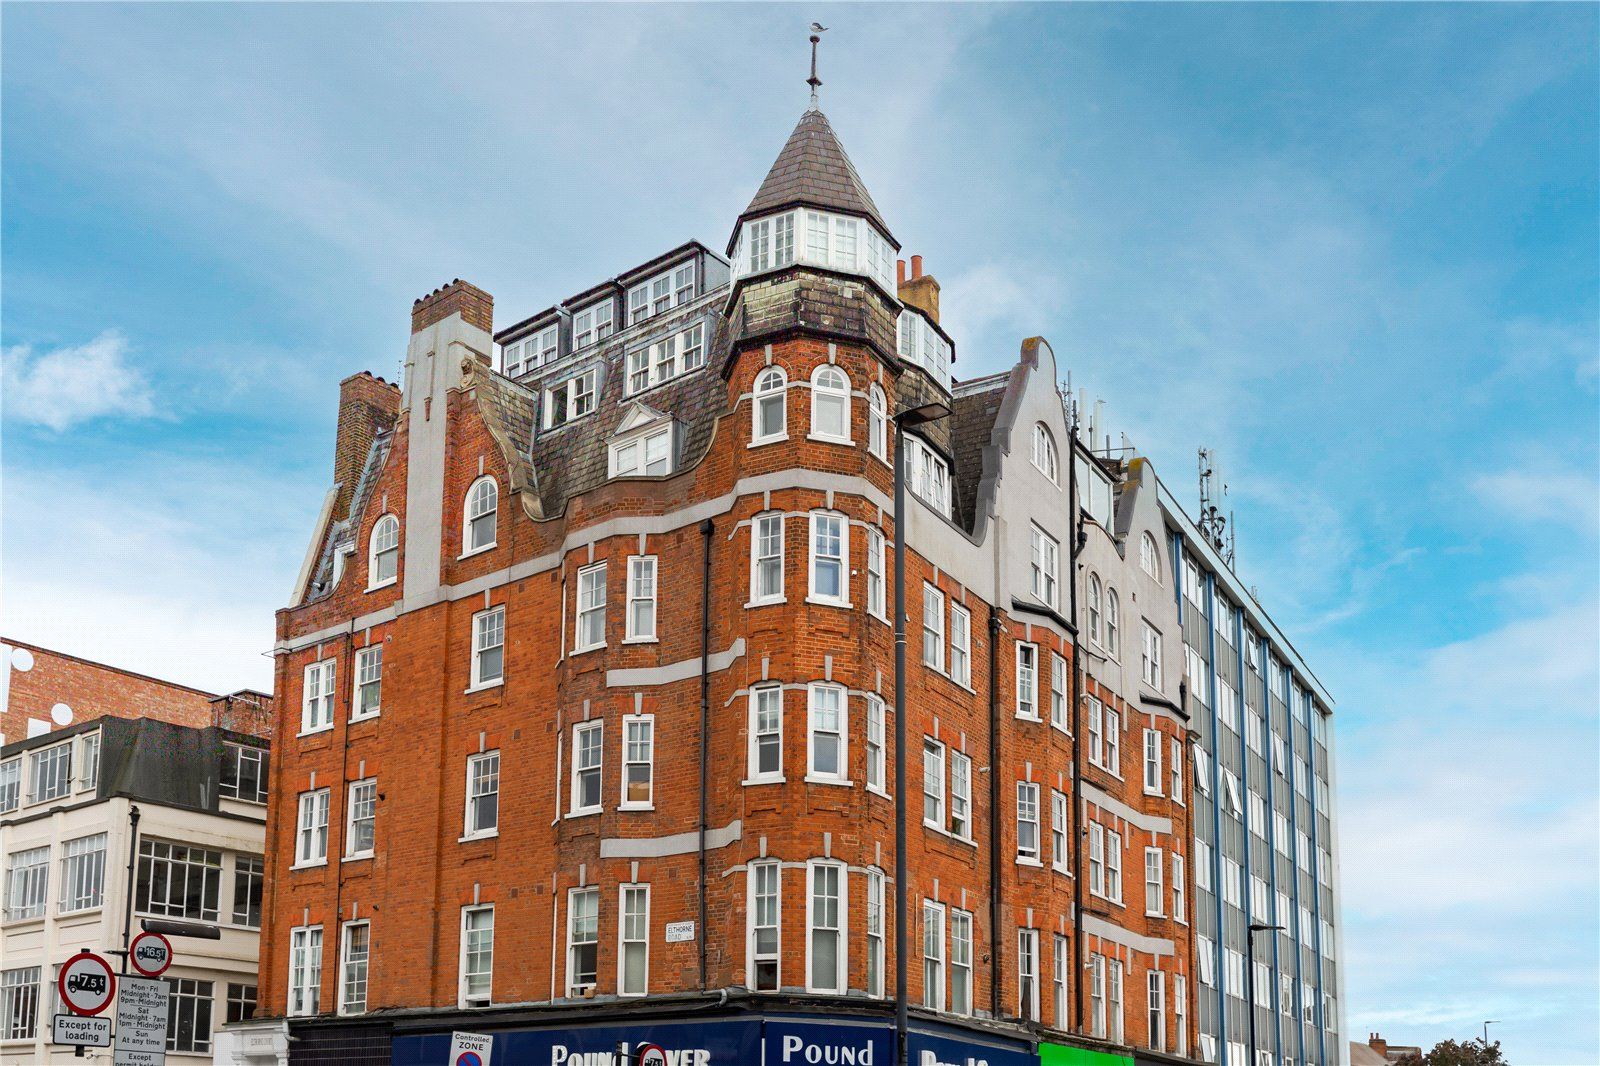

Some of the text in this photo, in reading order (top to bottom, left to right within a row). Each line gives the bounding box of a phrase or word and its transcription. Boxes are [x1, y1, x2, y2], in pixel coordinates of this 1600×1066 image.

[668, 925, 692, 933] ELTHORNE
[121, 990, 150, 998] Midnight
[138, 999, 166, 1007] Midnight
[119, 1013, 148, 1021] Midnight
[58, 1020, 107, 1031] Except for
[137, 1021, 166, 1031] Midnight
[65, 1032, 99, 1043] loading
[455, 1033, 490, 1042] Controlled
[459, 1042, 484, 1051] ZONE
[128, 1053, 152, 1061] Except
